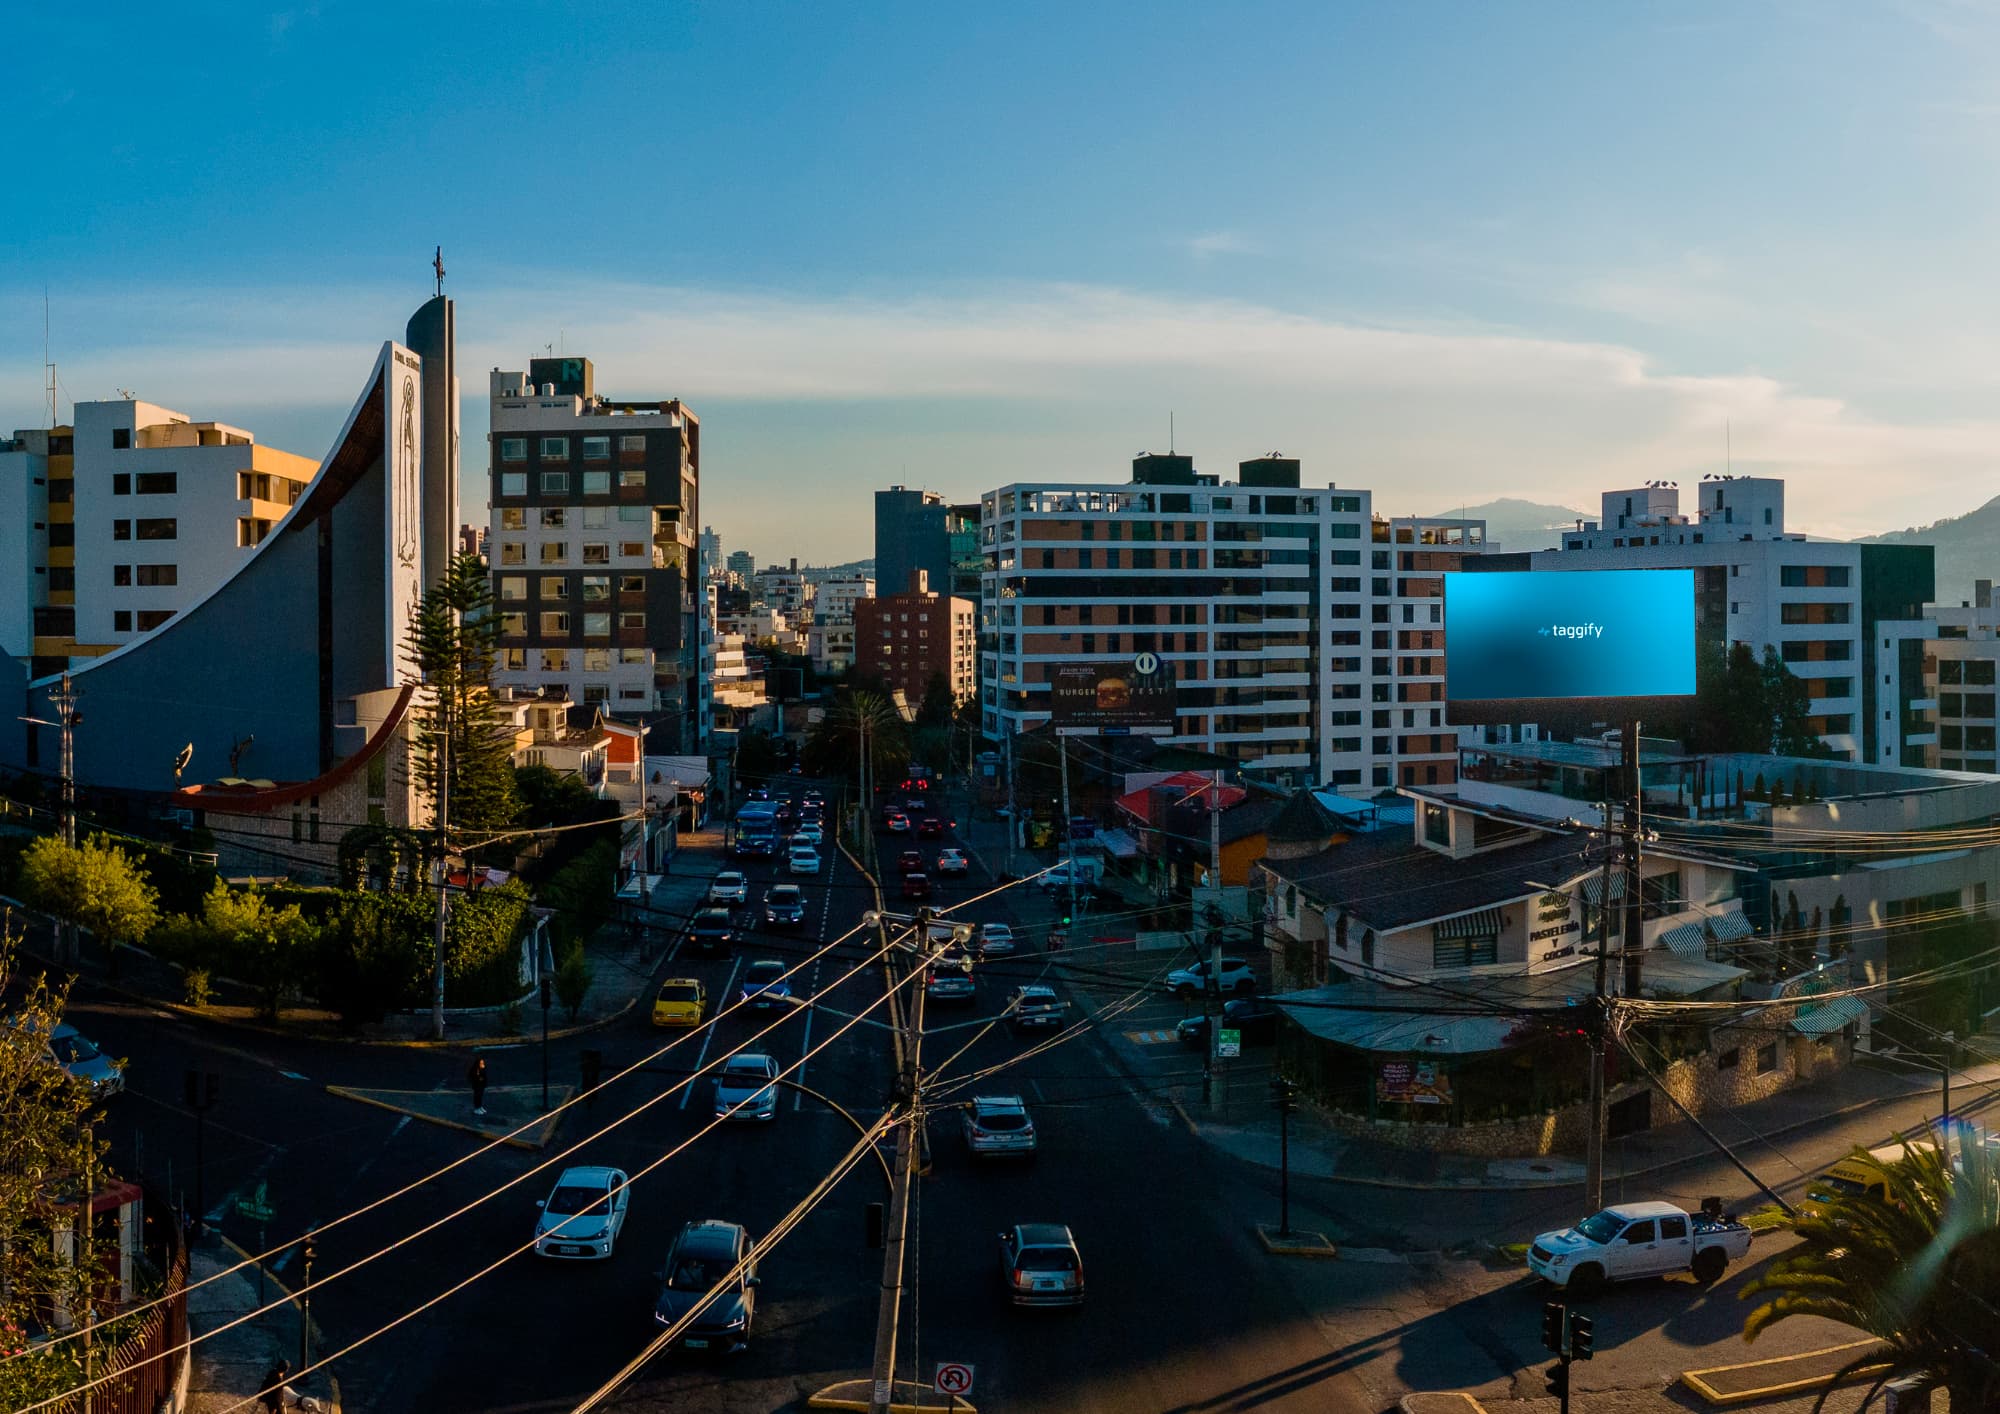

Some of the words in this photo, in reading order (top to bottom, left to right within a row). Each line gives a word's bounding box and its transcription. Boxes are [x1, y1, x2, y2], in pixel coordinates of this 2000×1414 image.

[562, 359, 583, 381] R
[1552, 622, 1604, 639] taggify
[1059, 687, 1096, 696] BURGER
[1529, 919, 1580, 942] PASTELERÍA
[1552, 938, 1559, 948] Y
[1543, 946, 1575, 962] COCINA
